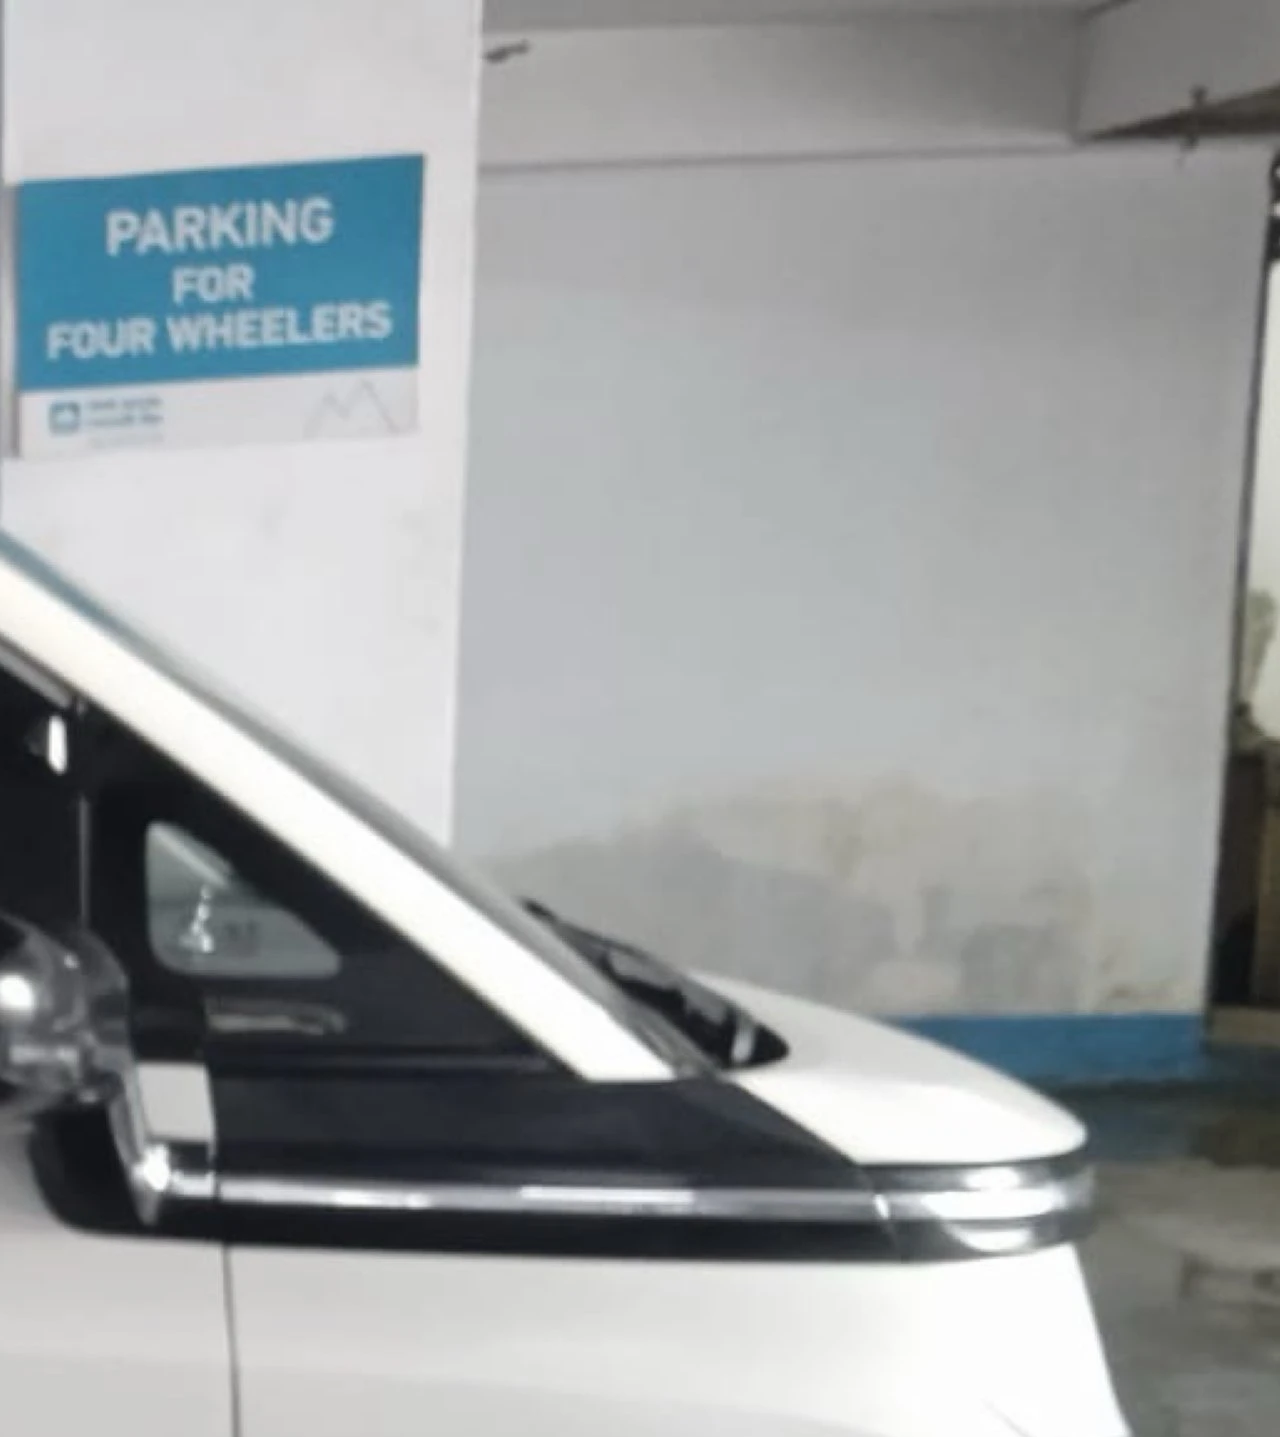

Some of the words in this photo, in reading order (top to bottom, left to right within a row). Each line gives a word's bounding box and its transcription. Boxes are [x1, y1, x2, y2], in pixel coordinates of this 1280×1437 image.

[105, 197, 335, 256] PARKING
[172, 263, 254, 304] FOR
[46, 318, 155, 360] FOUR
[167, 303, 394, 353] WHEELERS
